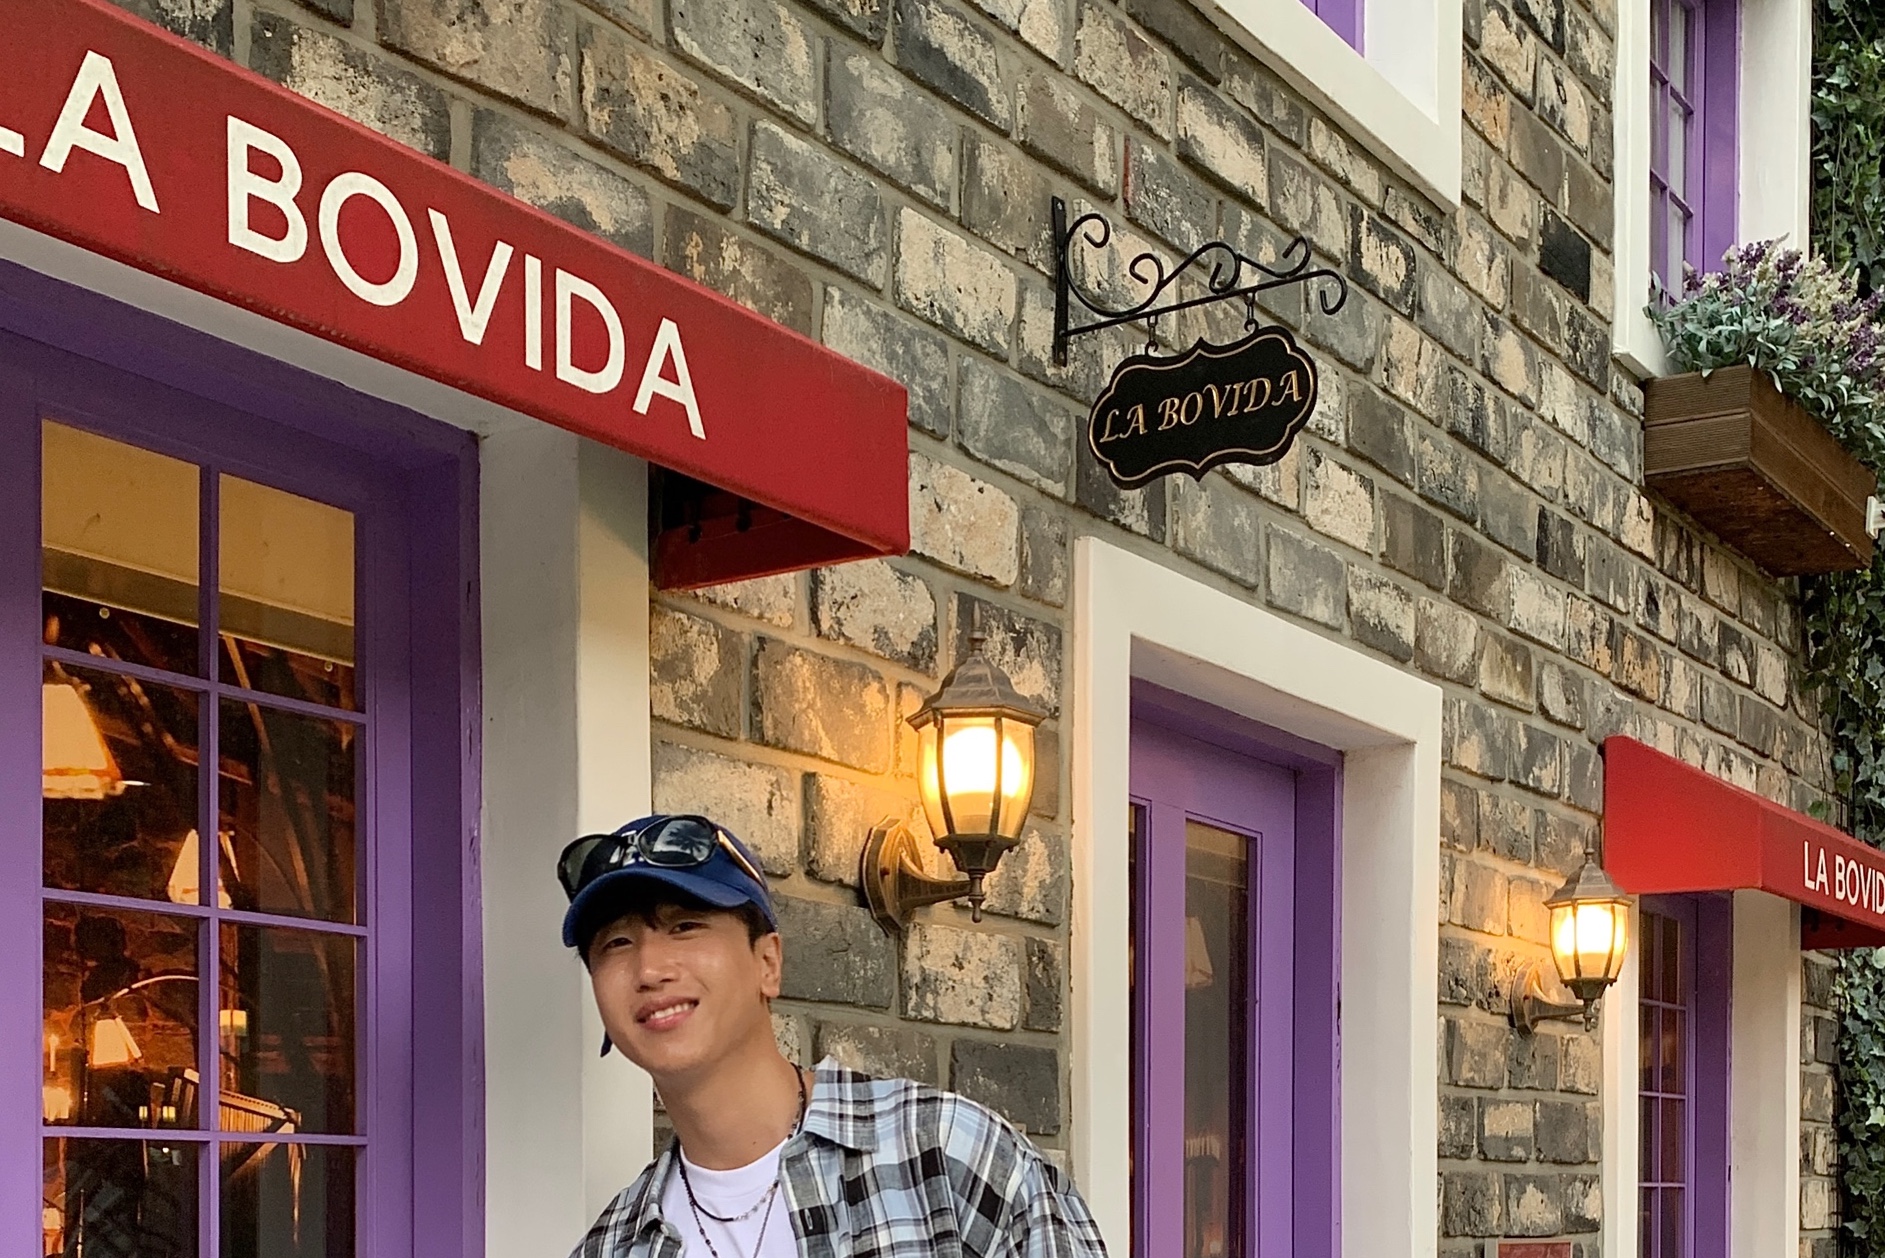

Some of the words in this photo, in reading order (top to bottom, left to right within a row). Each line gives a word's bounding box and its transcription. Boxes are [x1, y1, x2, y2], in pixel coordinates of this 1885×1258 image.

[227, 115, 706, 440] BOVIDA
[1099, 403, 1148, 443] LA
[1157, 369, 1303, 431] BOVIDA
[1804, 840, 1830, 896] LA
[1835, 854, 1885, 915] BOVID
